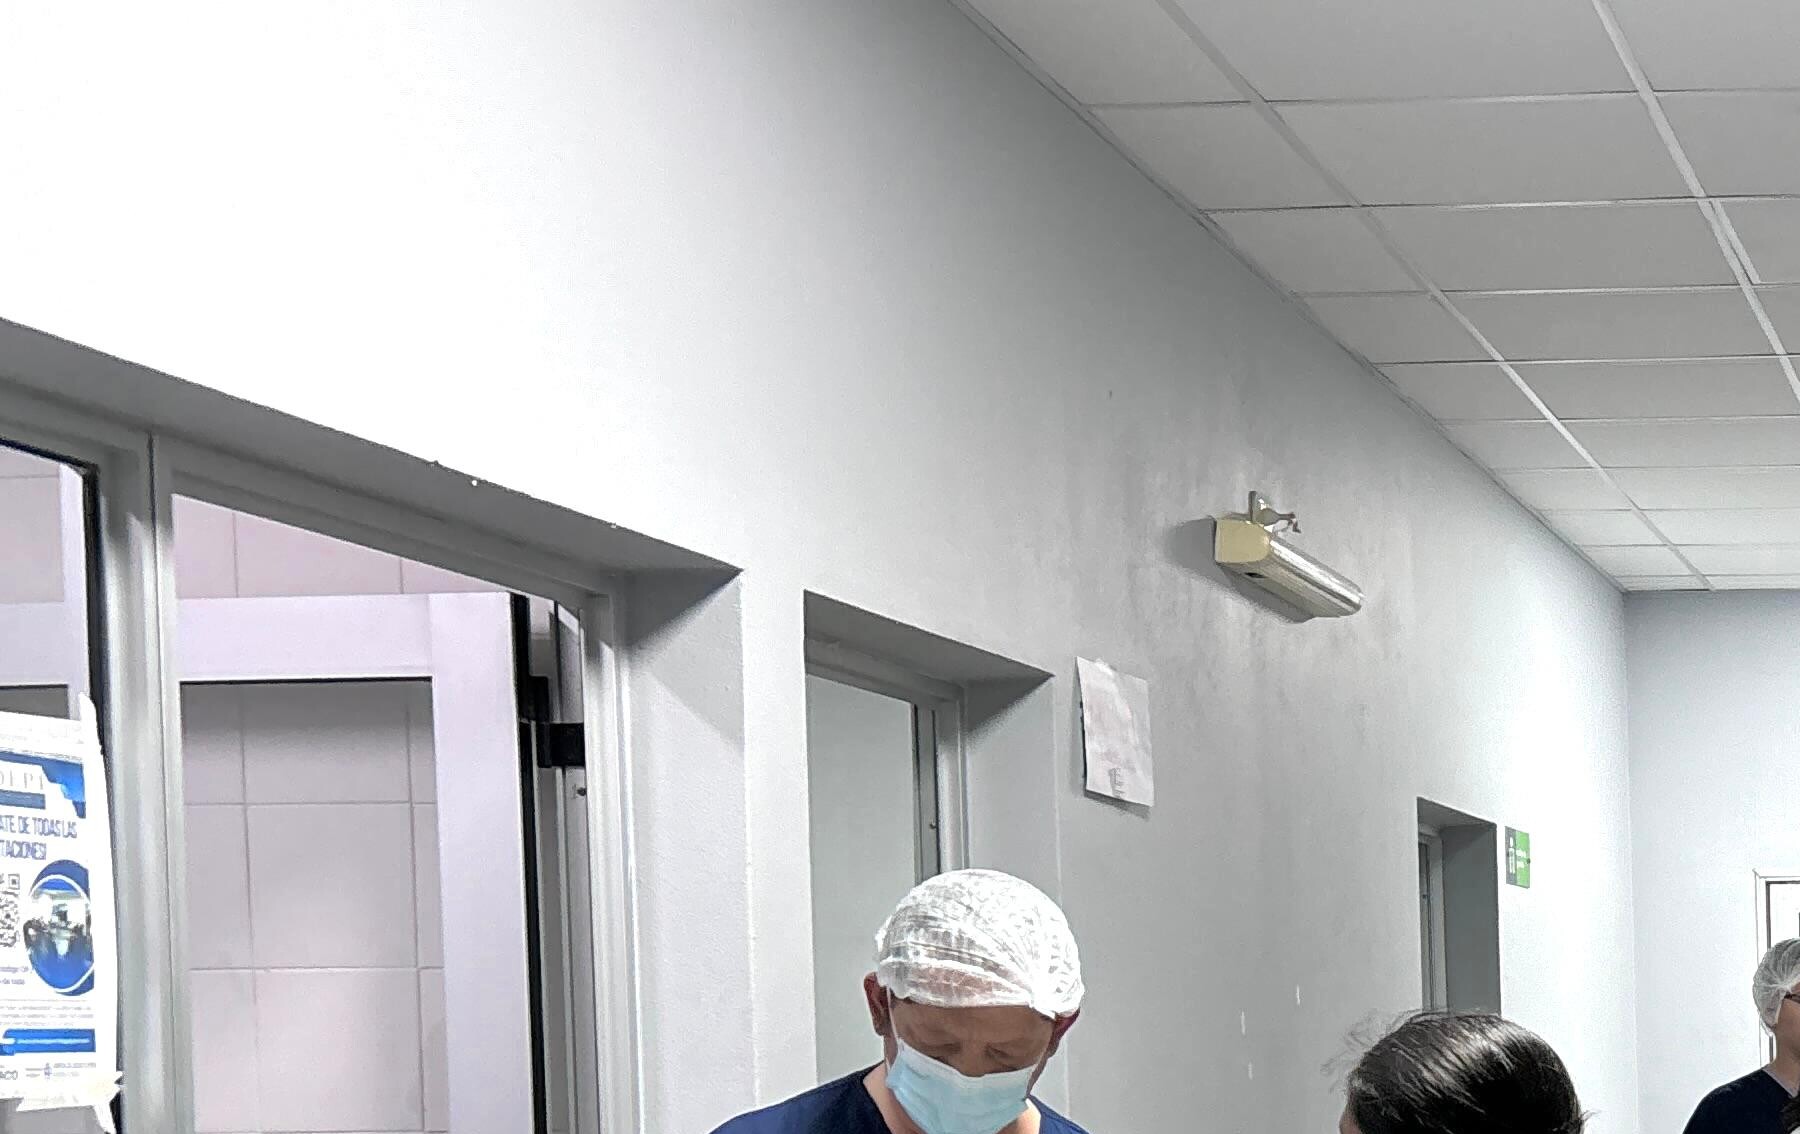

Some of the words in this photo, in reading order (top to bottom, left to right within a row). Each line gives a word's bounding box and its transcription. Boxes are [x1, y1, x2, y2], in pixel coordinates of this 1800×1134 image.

[18, 816, 30, 834] DE
[32, 817, 61, 837] TODAS
[62, 820, 77, 838] LAS
